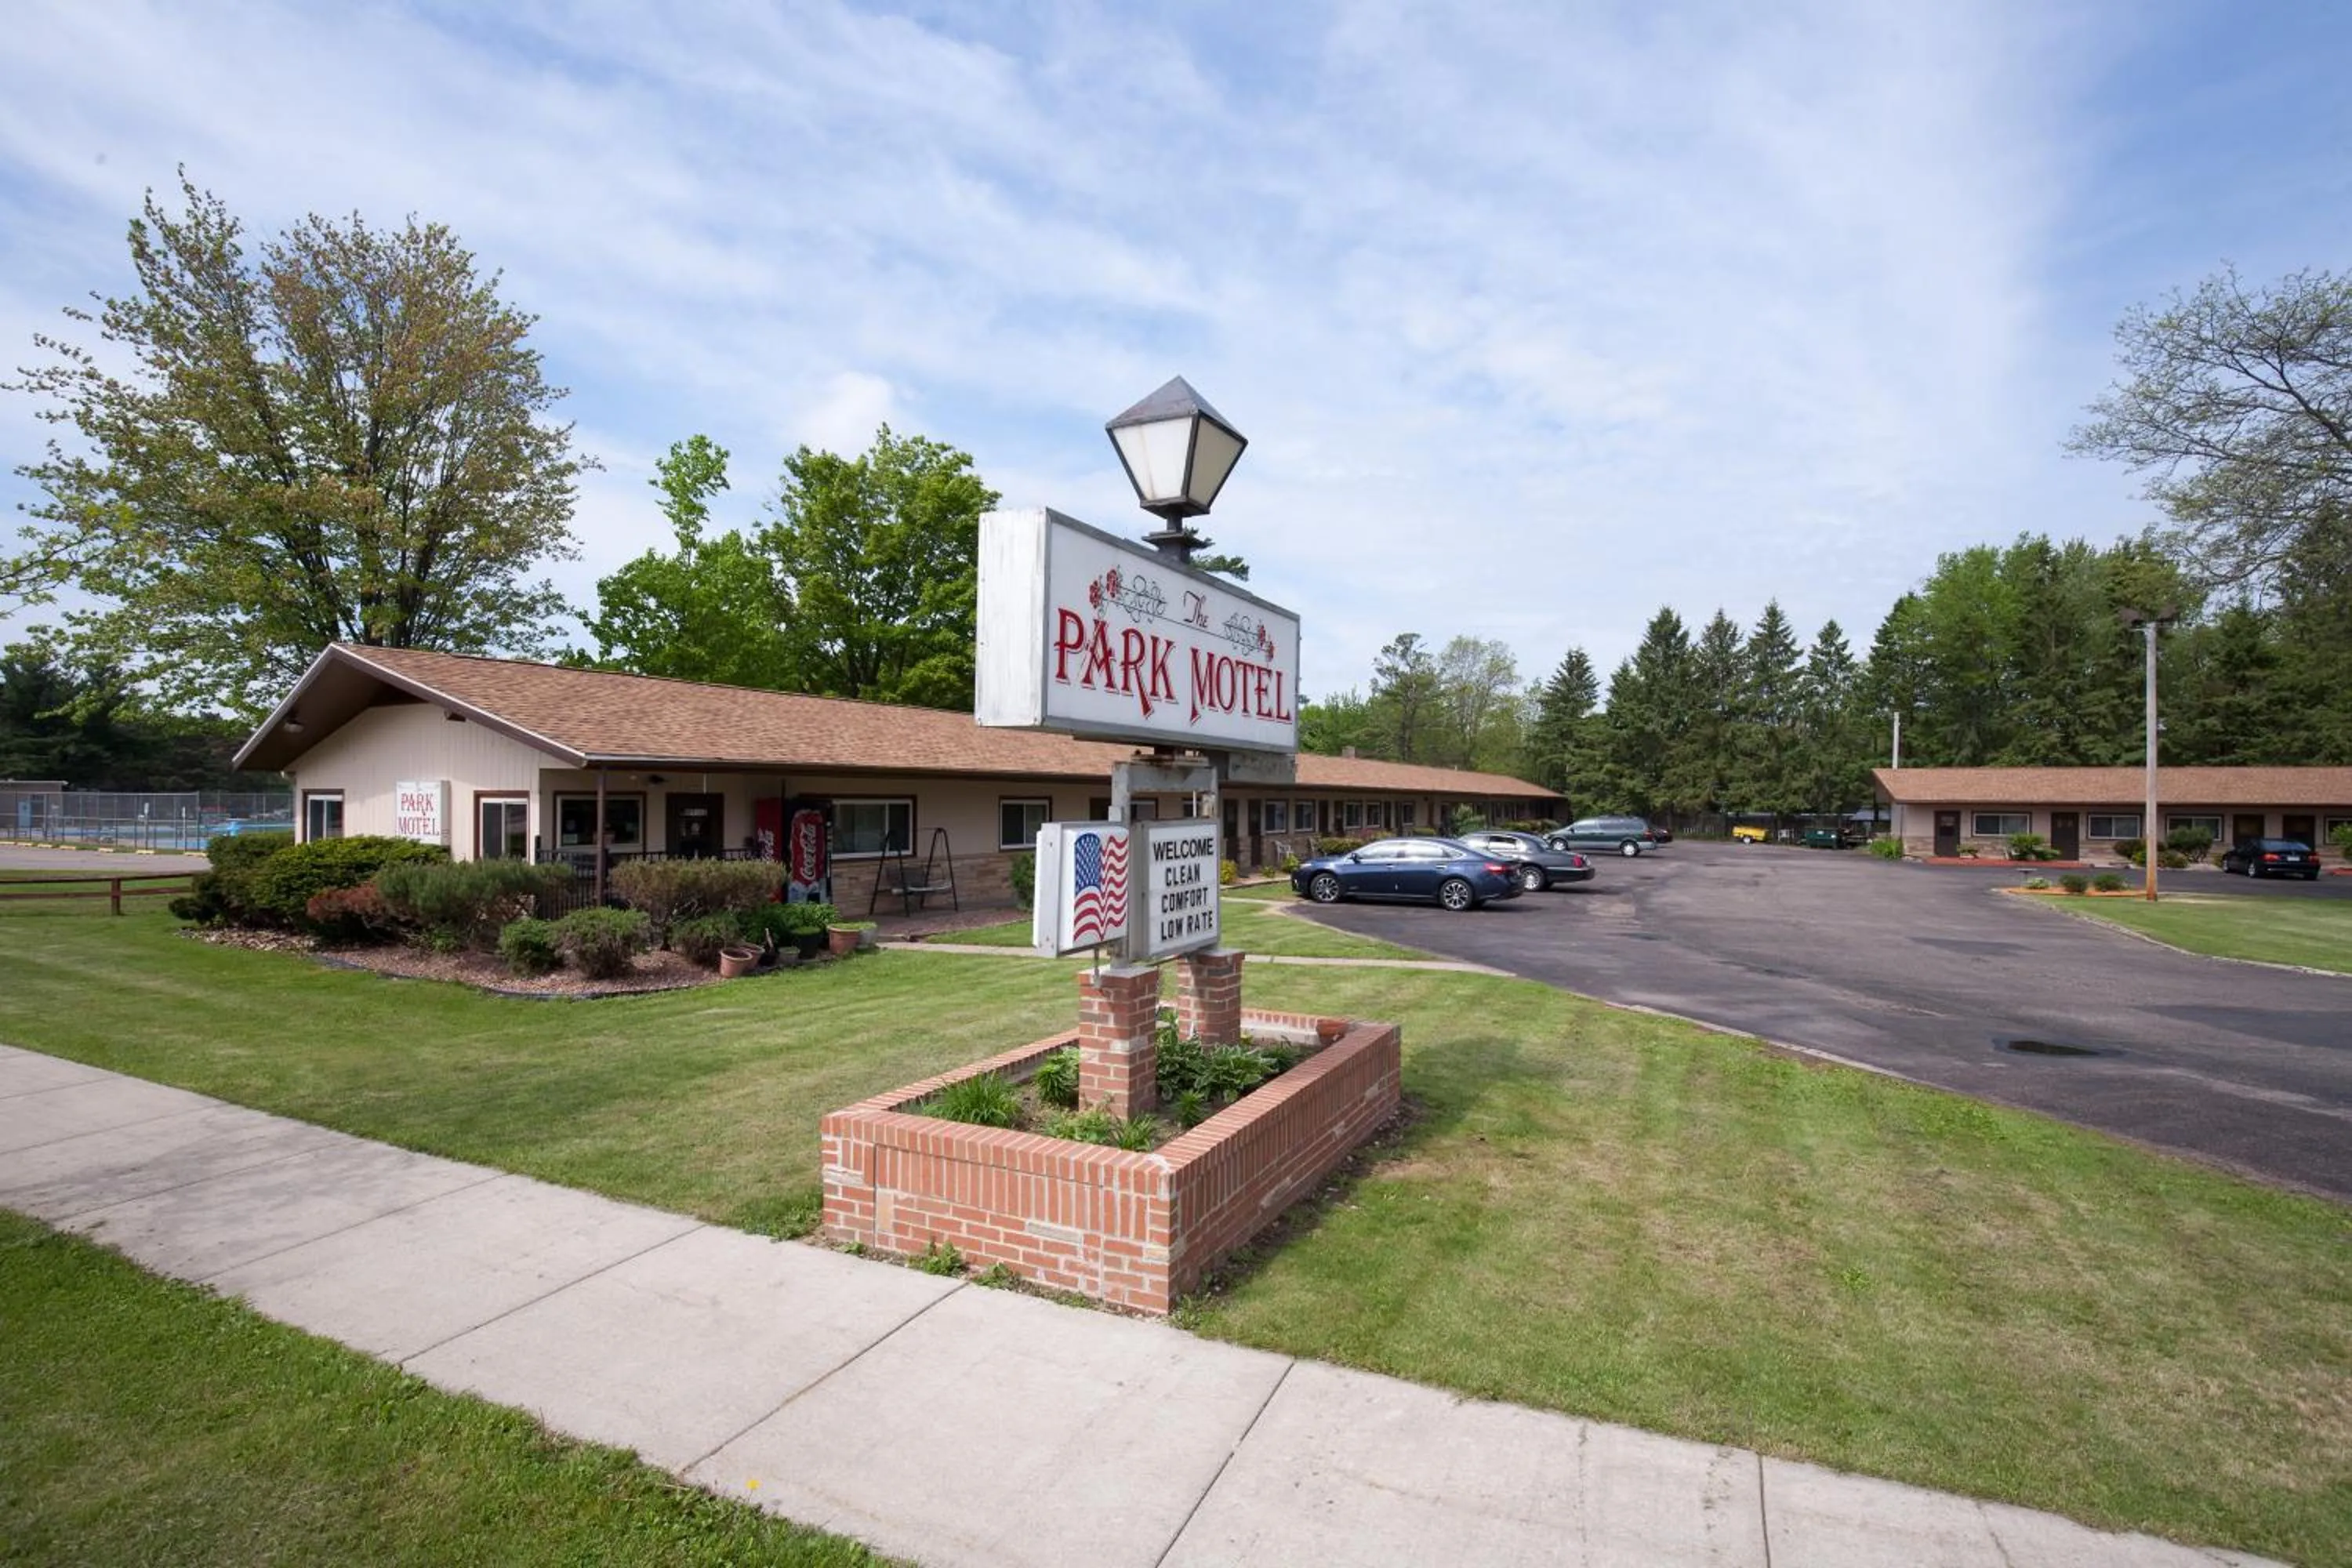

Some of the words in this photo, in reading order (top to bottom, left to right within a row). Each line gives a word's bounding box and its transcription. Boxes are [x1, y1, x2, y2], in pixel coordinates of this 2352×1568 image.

[1183, 590, 1208, 627] The
[1054, 608, 1178, 719] PARK
[1189, 648, 1292, 725] MOTEL
[401, 793, 434, 815] PARK
[398, 816, 441, 836] MOTEL
[1153, 837, 1214, 861] WELCOME
[1164, 863, 1201, 887] CLEAN
[1161, 887, 1208, 913] COMFORT
[1161, 917, 1184, 941] LOW
[1186, 910, 1213, 934] RATE
